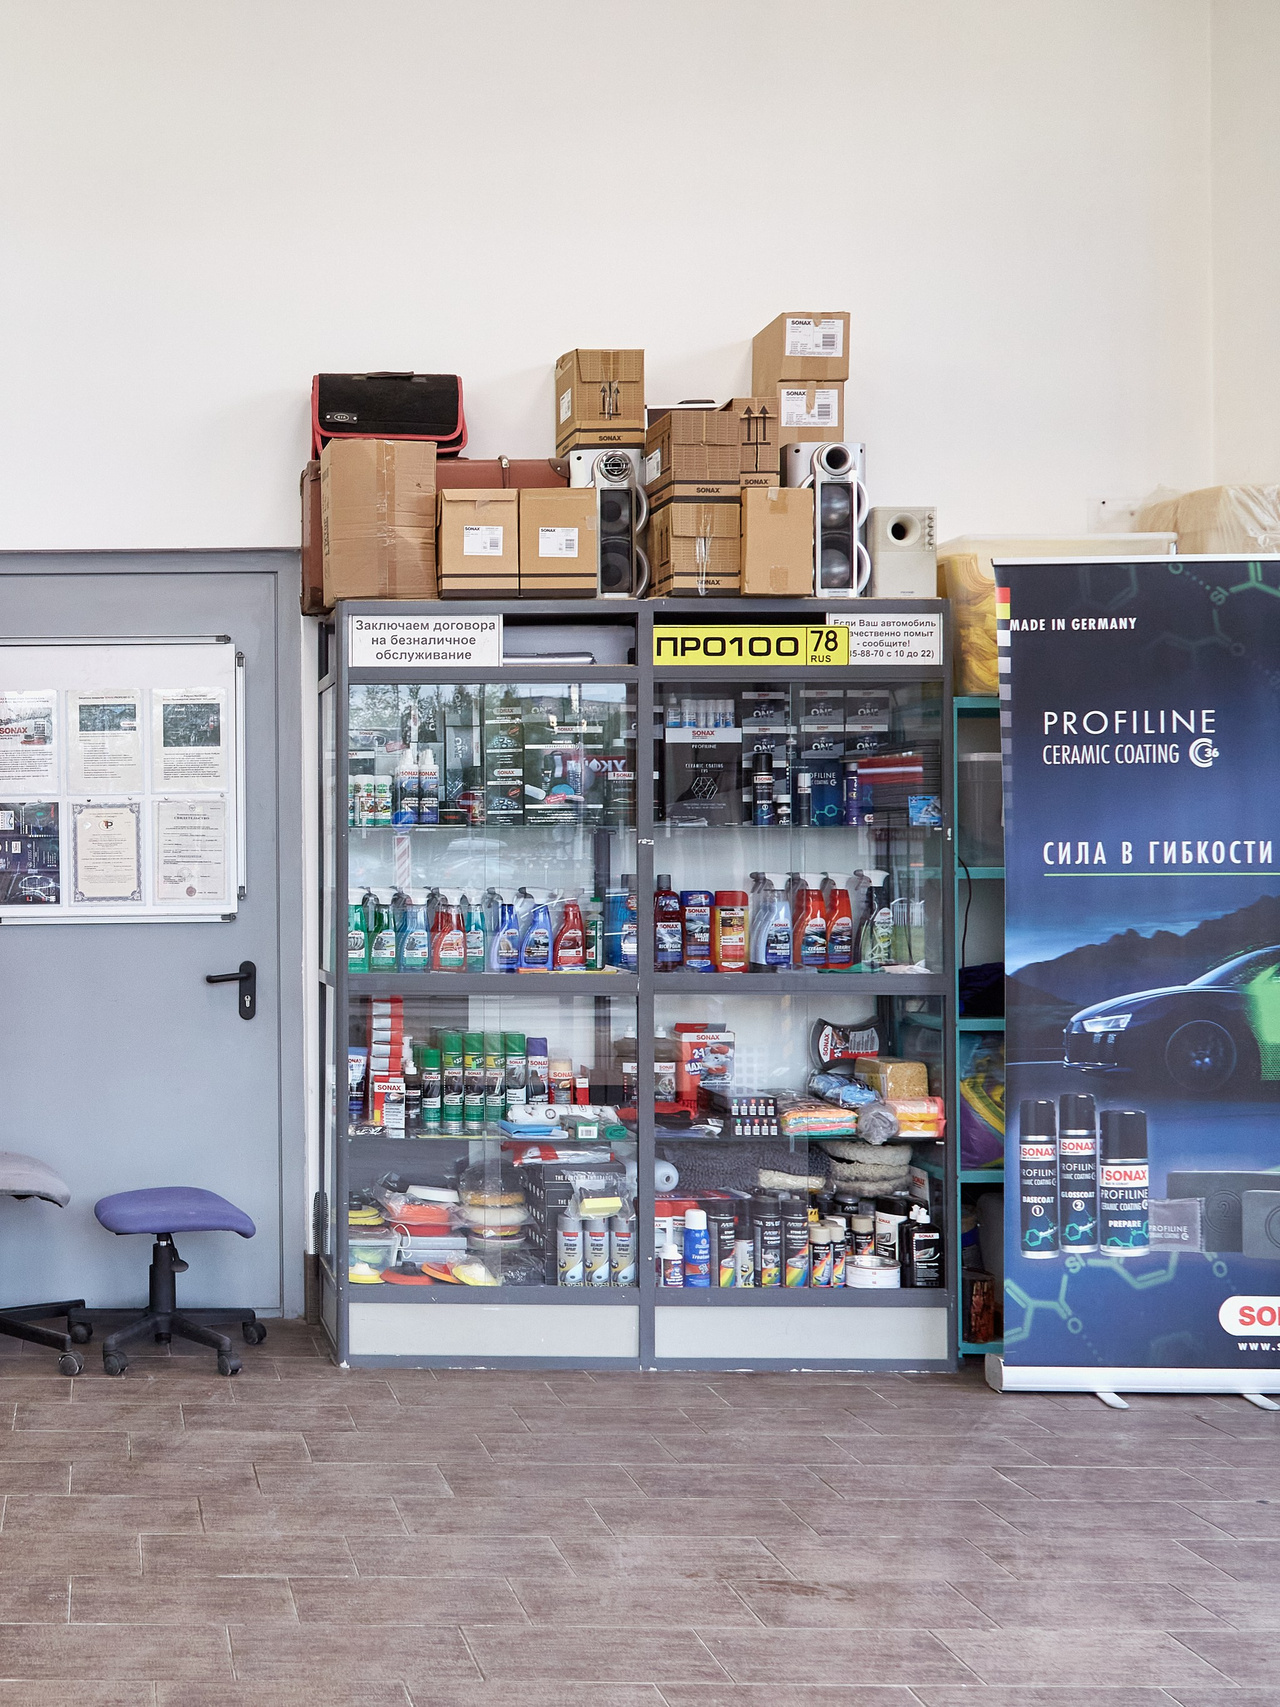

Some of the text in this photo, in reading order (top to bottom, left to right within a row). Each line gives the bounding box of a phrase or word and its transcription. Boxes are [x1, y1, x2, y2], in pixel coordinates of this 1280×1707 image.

[355, 620, 496, 633] Заключаем договора
[859, 619, 878, 627] Ваш
[880, 619, 937, 627] автомобиль
[1009, 617, 1137, 631] MADE IN GERMANY
[371, 635, 476, 645] на безналичное
[810, 630, 838, 652] 78
[862, 640, 910, 648] сообщите!
[656, 636, 800, 657] ПРО100
[375, 649, 472, 661] обслуживание
[810, 654, 832, 663] RUS
[895, 650, 904, 658] 10
[906, 651, 918, 659] до
[920, 650, 935, 658] 22)
[753, 710, 774, 718] ONE
[811, 708, 833, 716] ONE
[858, 708, 879, 716] ONE
[1044, 709, 1216, 735] PROFILINE
[754, 744, 776, 752] ONE
[812, 743, 834, 751] ONE
[857, 742, 878, 751] ONE
[1043, 743, 1180, 765] CERAMIC COATING
[1043, 840, 1273, 865] СИЛА В ГИБКОСТИ
[1062, 1141, 1096, 1151] SONAX
[1022, 1147, 1056, 1157] SONAX
[1105, 1170, 1147, 1182] SONAX
[1061, 1191, 1095, 1199] GLOSSCOAT
[1120, 1202, 1141, 1210] COATING
[1108, 1220, 1142, 1228] PREPARE
[1238, 1305, 1280, 1327] SO
